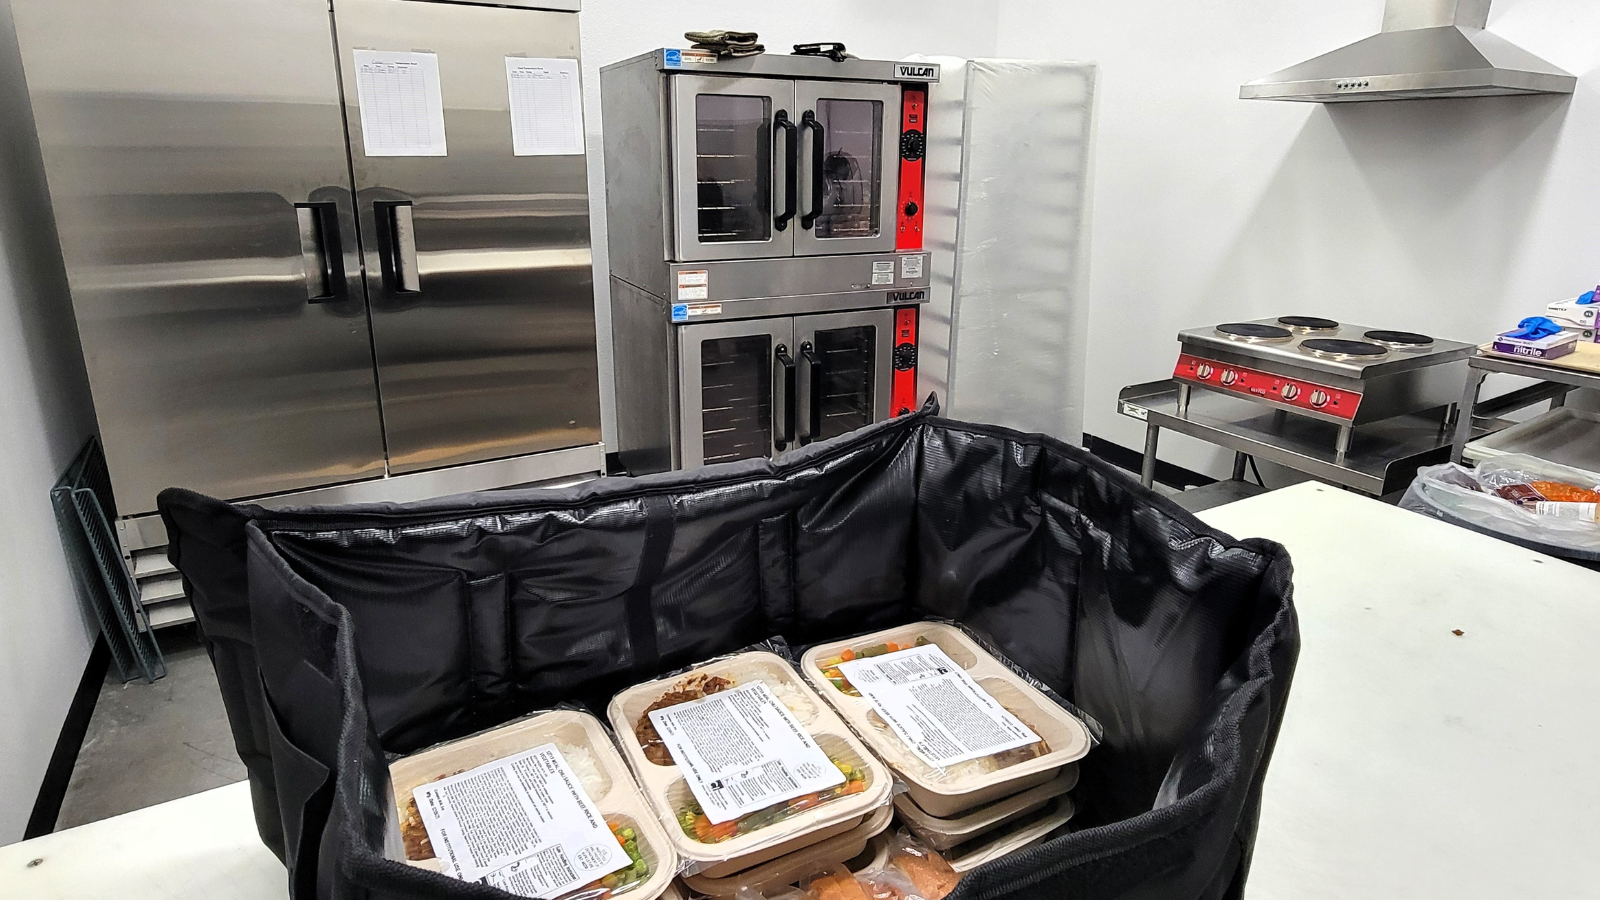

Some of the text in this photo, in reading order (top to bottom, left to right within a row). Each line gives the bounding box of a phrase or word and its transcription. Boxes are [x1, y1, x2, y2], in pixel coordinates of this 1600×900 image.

[900, 66, 934, 77] VULCAN
[893, 291, 925, 301] VULCAN
[1513, 345, 1542, 356] nitrile
[538, 752, 556, 774] VEGETABLES
[562, 776, 575, 789] SAUCE
[588, 818, 599, 828] AND
